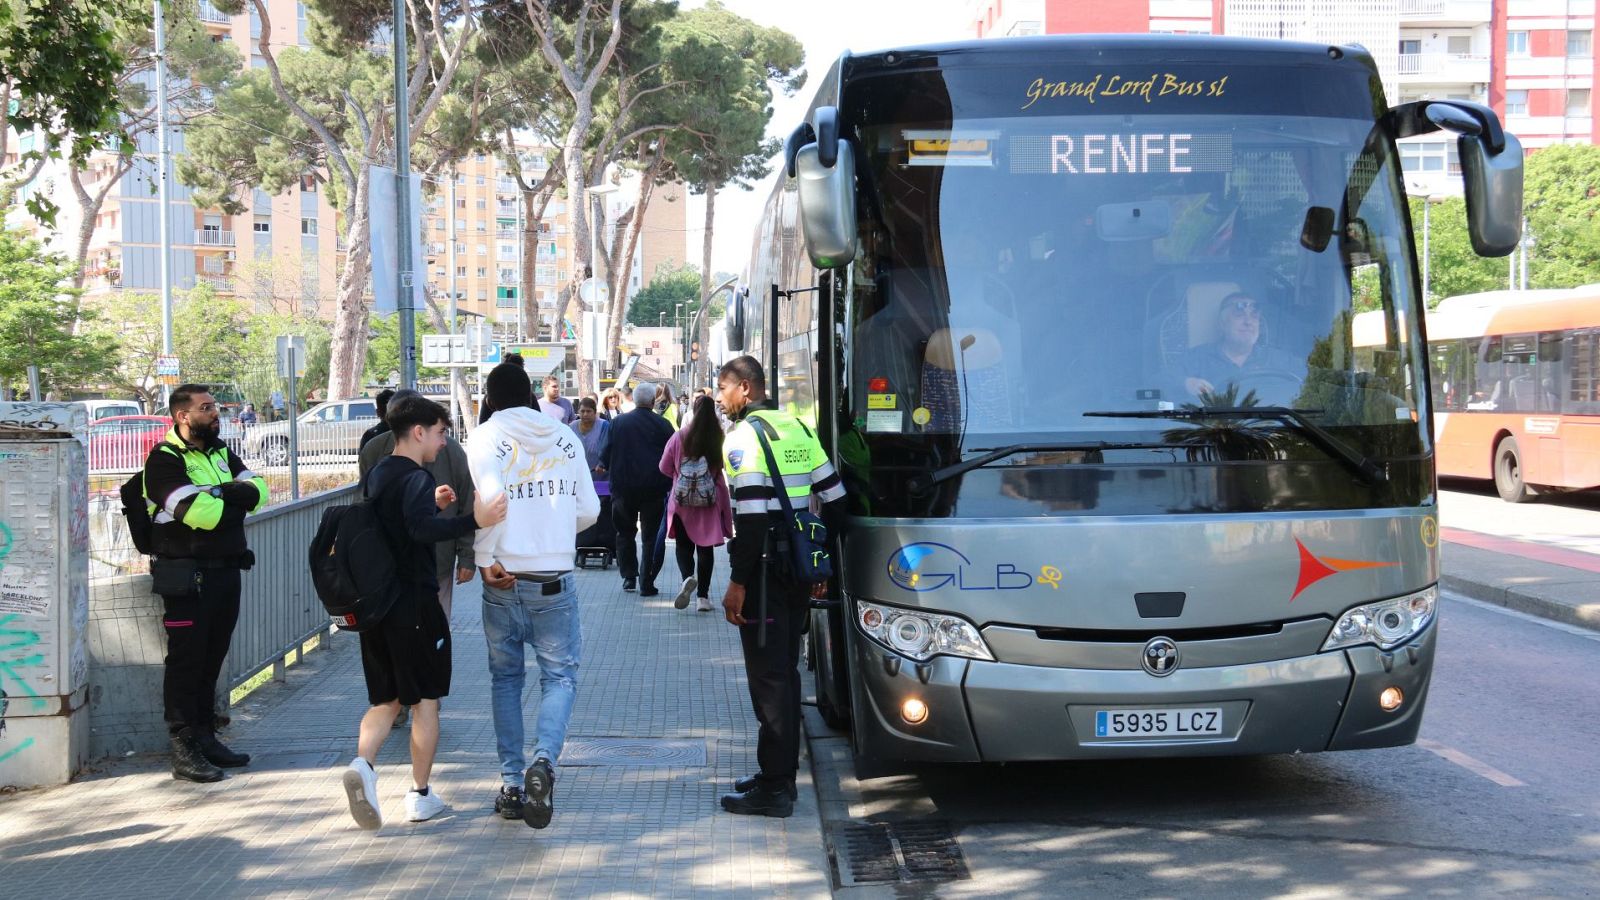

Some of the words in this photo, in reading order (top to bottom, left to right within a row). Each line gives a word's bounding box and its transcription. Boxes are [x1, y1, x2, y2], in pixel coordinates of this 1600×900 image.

[1021, 74, 1102, 110] Grand
[1100, 74, 1158, 103] Lord
[1158, 73, 1204, 96] Bus
[1206, 75, 1229, 96] sl
[1051, 134, 1193, 174] RENFE
[784, 449, 811, 464] SEGURIDA
[504, 479, 577, 500] SKETBAL
[1112, 713, 1168, 733] 5935
[1176, 711, 1218, 732] LCZ
